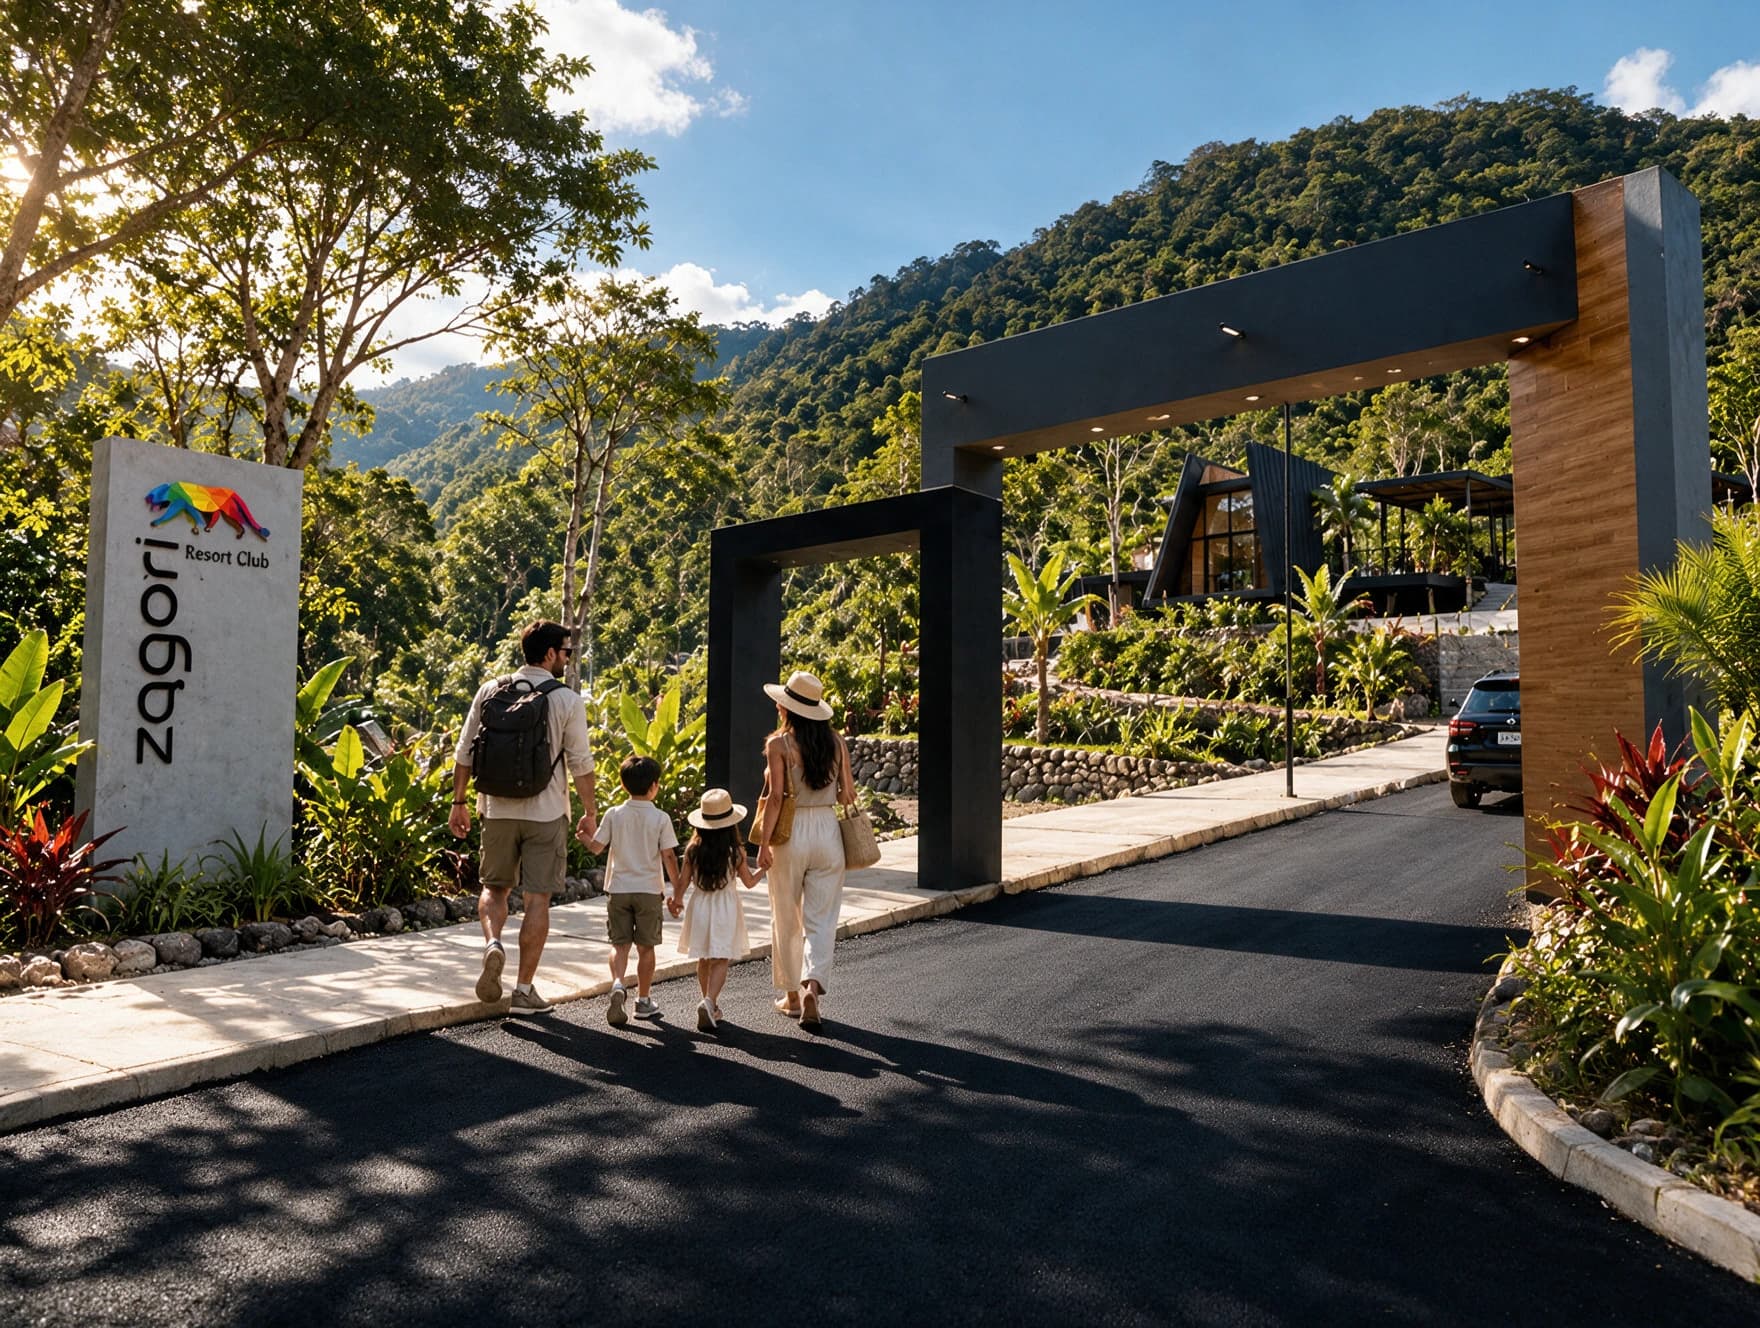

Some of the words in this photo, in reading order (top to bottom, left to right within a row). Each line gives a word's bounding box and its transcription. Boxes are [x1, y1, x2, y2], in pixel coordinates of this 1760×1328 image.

[185, 544, 232, 566] Resort
[237, 552, 270, 569] Club
[135, 537, 192, 765] zagori
